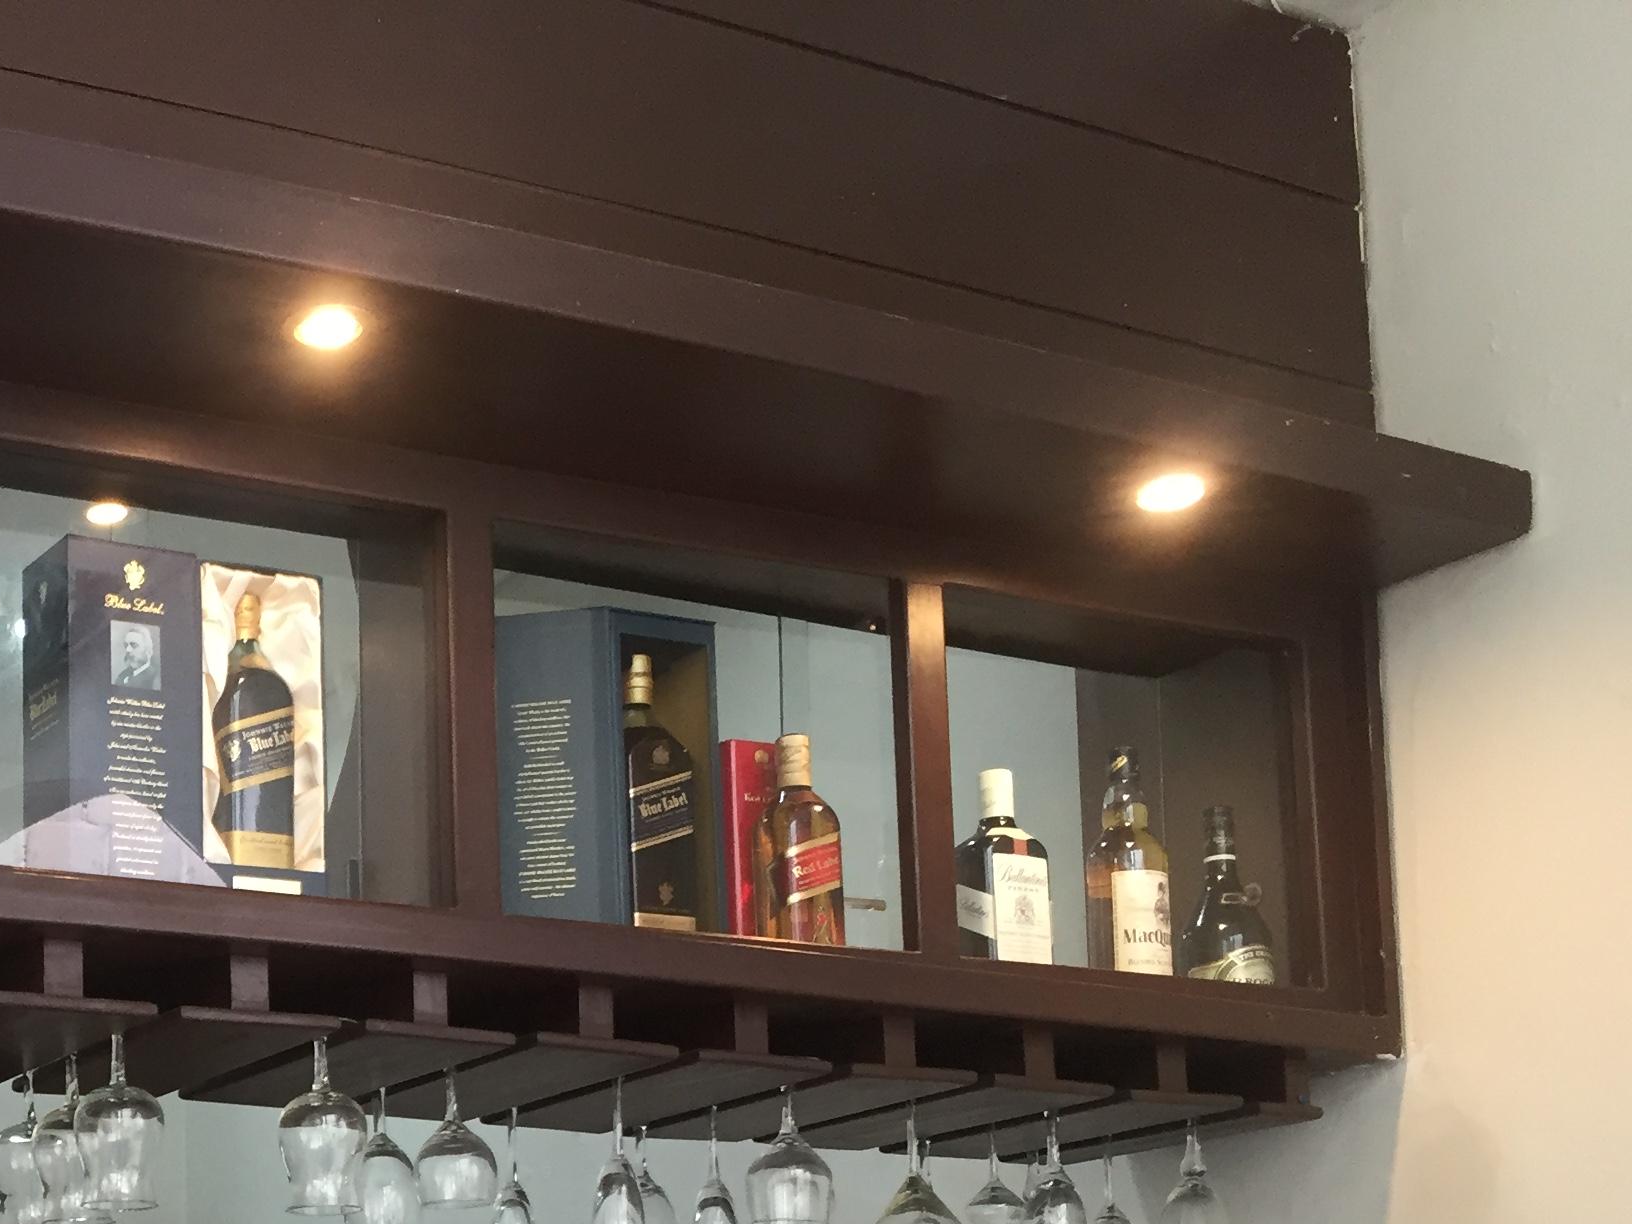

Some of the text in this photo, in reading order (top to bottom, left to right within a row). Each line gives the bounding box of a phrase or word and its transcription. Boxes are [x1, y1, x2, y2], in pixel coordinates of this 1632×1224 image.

[247, 737, 274, 755] Blue
[638, 802, 663, 819] Blue
[661, 792, 688, 812] Label
